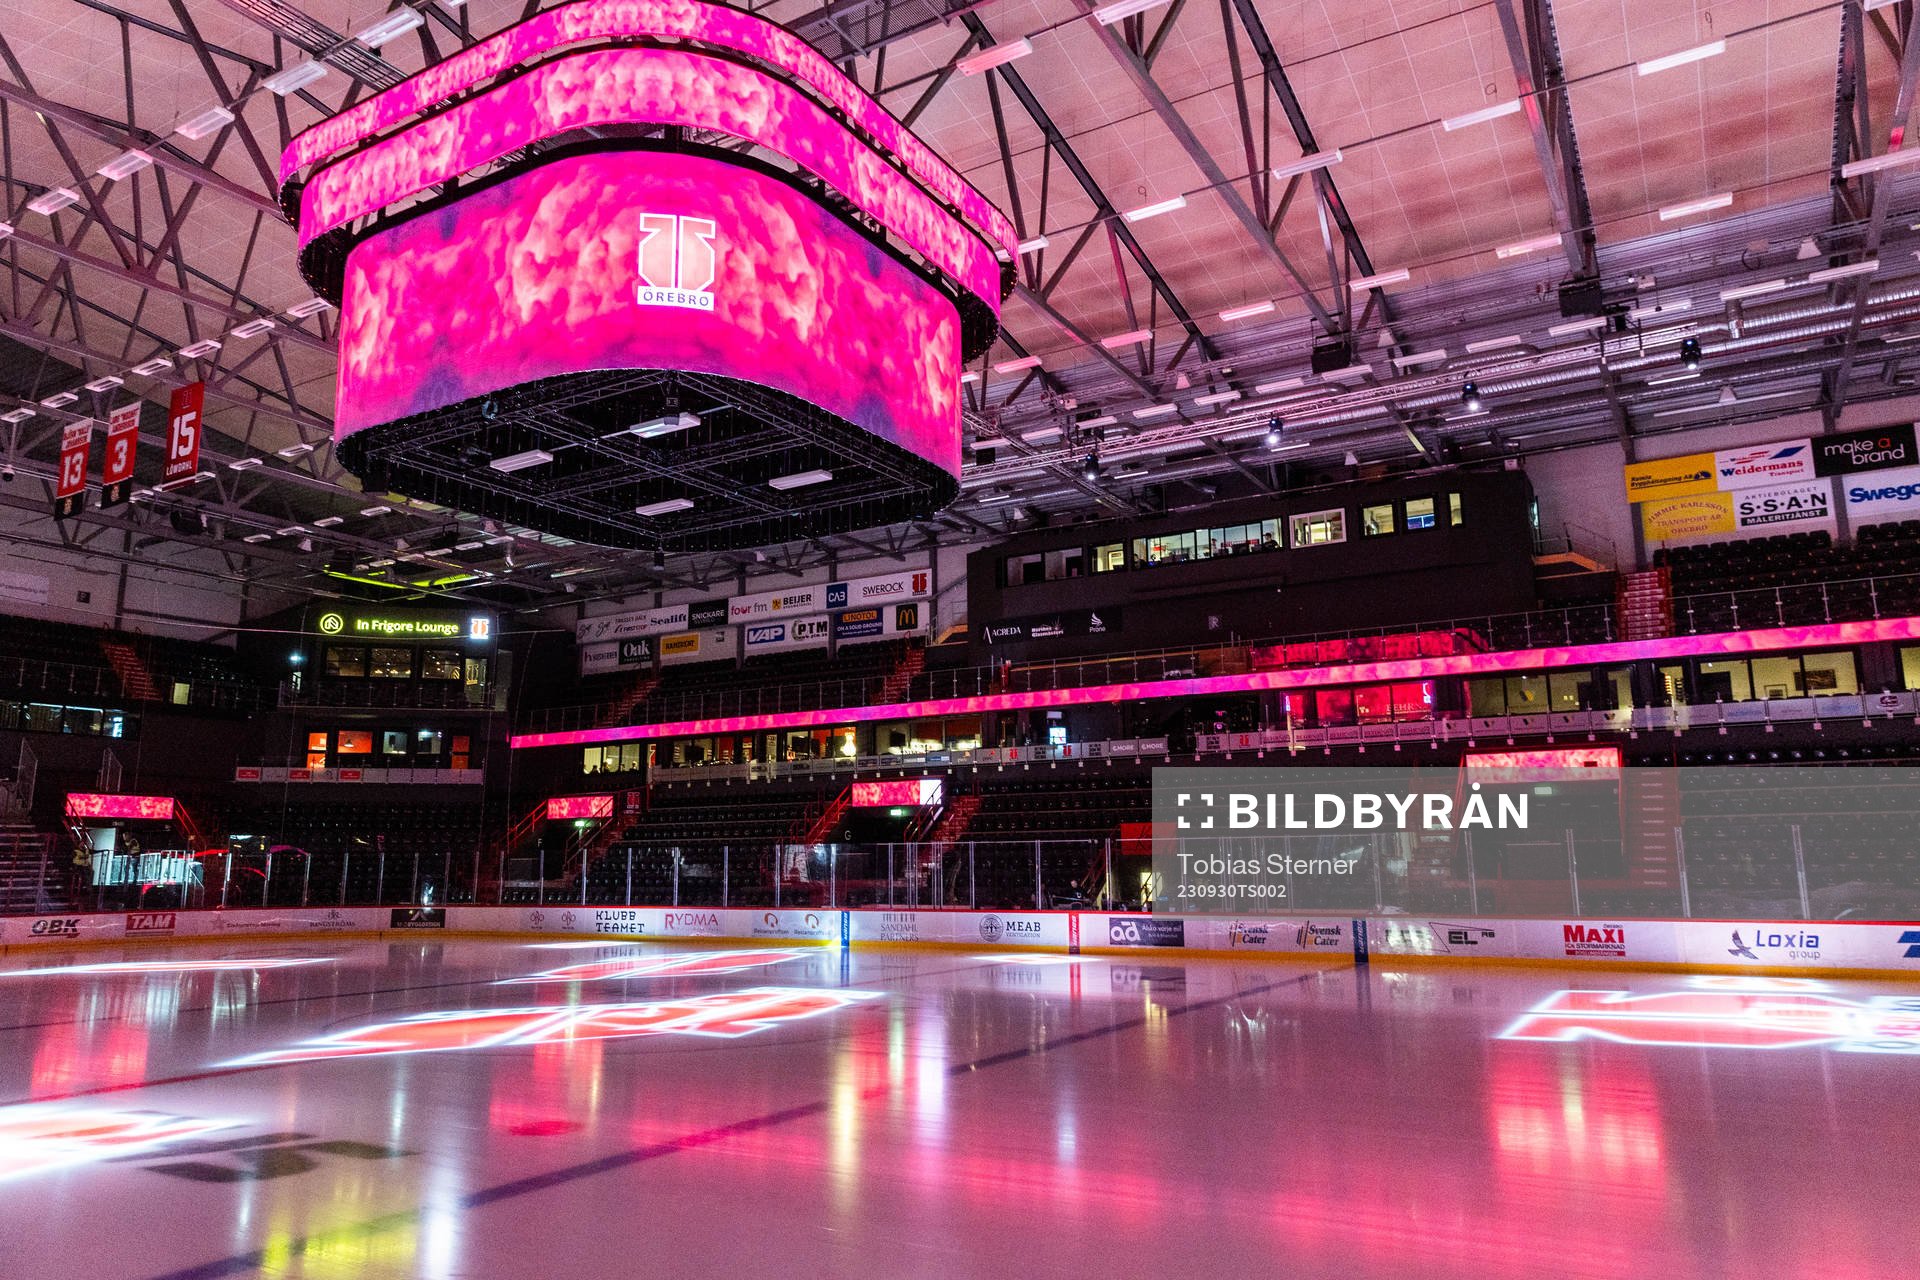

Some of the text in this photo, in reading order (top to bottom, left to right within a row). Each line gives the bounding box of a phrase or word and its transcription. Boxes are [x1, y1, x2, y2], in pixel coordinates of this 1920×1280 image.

[643, 289, 709, 307] ÖREBRO
[171, 411, 196, 460] 15
[1824, 437, 1891, 459] make a
[1852, 443, 1905, 465] brand
[112, 439, 128, 473] 3
[62, 452, 84, 489] 13
[1721, 460, 1804, 476] Weidermans
[1769, 468, 1804, 478] Transport
[1744, 486, 1818, 500] AKTIEBOLAGET
[1648, 503, 1678, 523] JIMMIE
[1657, 516, 1707, 527] TRANSPORT
[863, 581, 904, 596] SWEROCK
[783, 594, 812, 606] BEIJER
[691, 609, 725, 621] SNICKARE
[731, 601, 768, 616] four fm
[357, 619, 460, 635] In Frigore Lounge
[650, 613, 687, 627] Sealift
[748, 626, 784, 643] VAP
[797, 621, 828, 635] PTM
[624, 639, 650, 657] Oak
[132, 914, 170, 928] TAM
[596, 910, 637, 921] KLUBB
[665, 913, 719, 929] RYDMA
[596, 923, 645, 933] TEAMET
[1006, 921, 1041, 932] MEAB
[1309, 925, 1342, 936] Svensk
[1242, 934, 1267, 944] Cater
[1314, 936, 1340, 946] Cater
[1448, 931, 1478, 945] EL
[1756, 930, 1819, 948] Loxia
[1789, 950, 1821, 961] group
